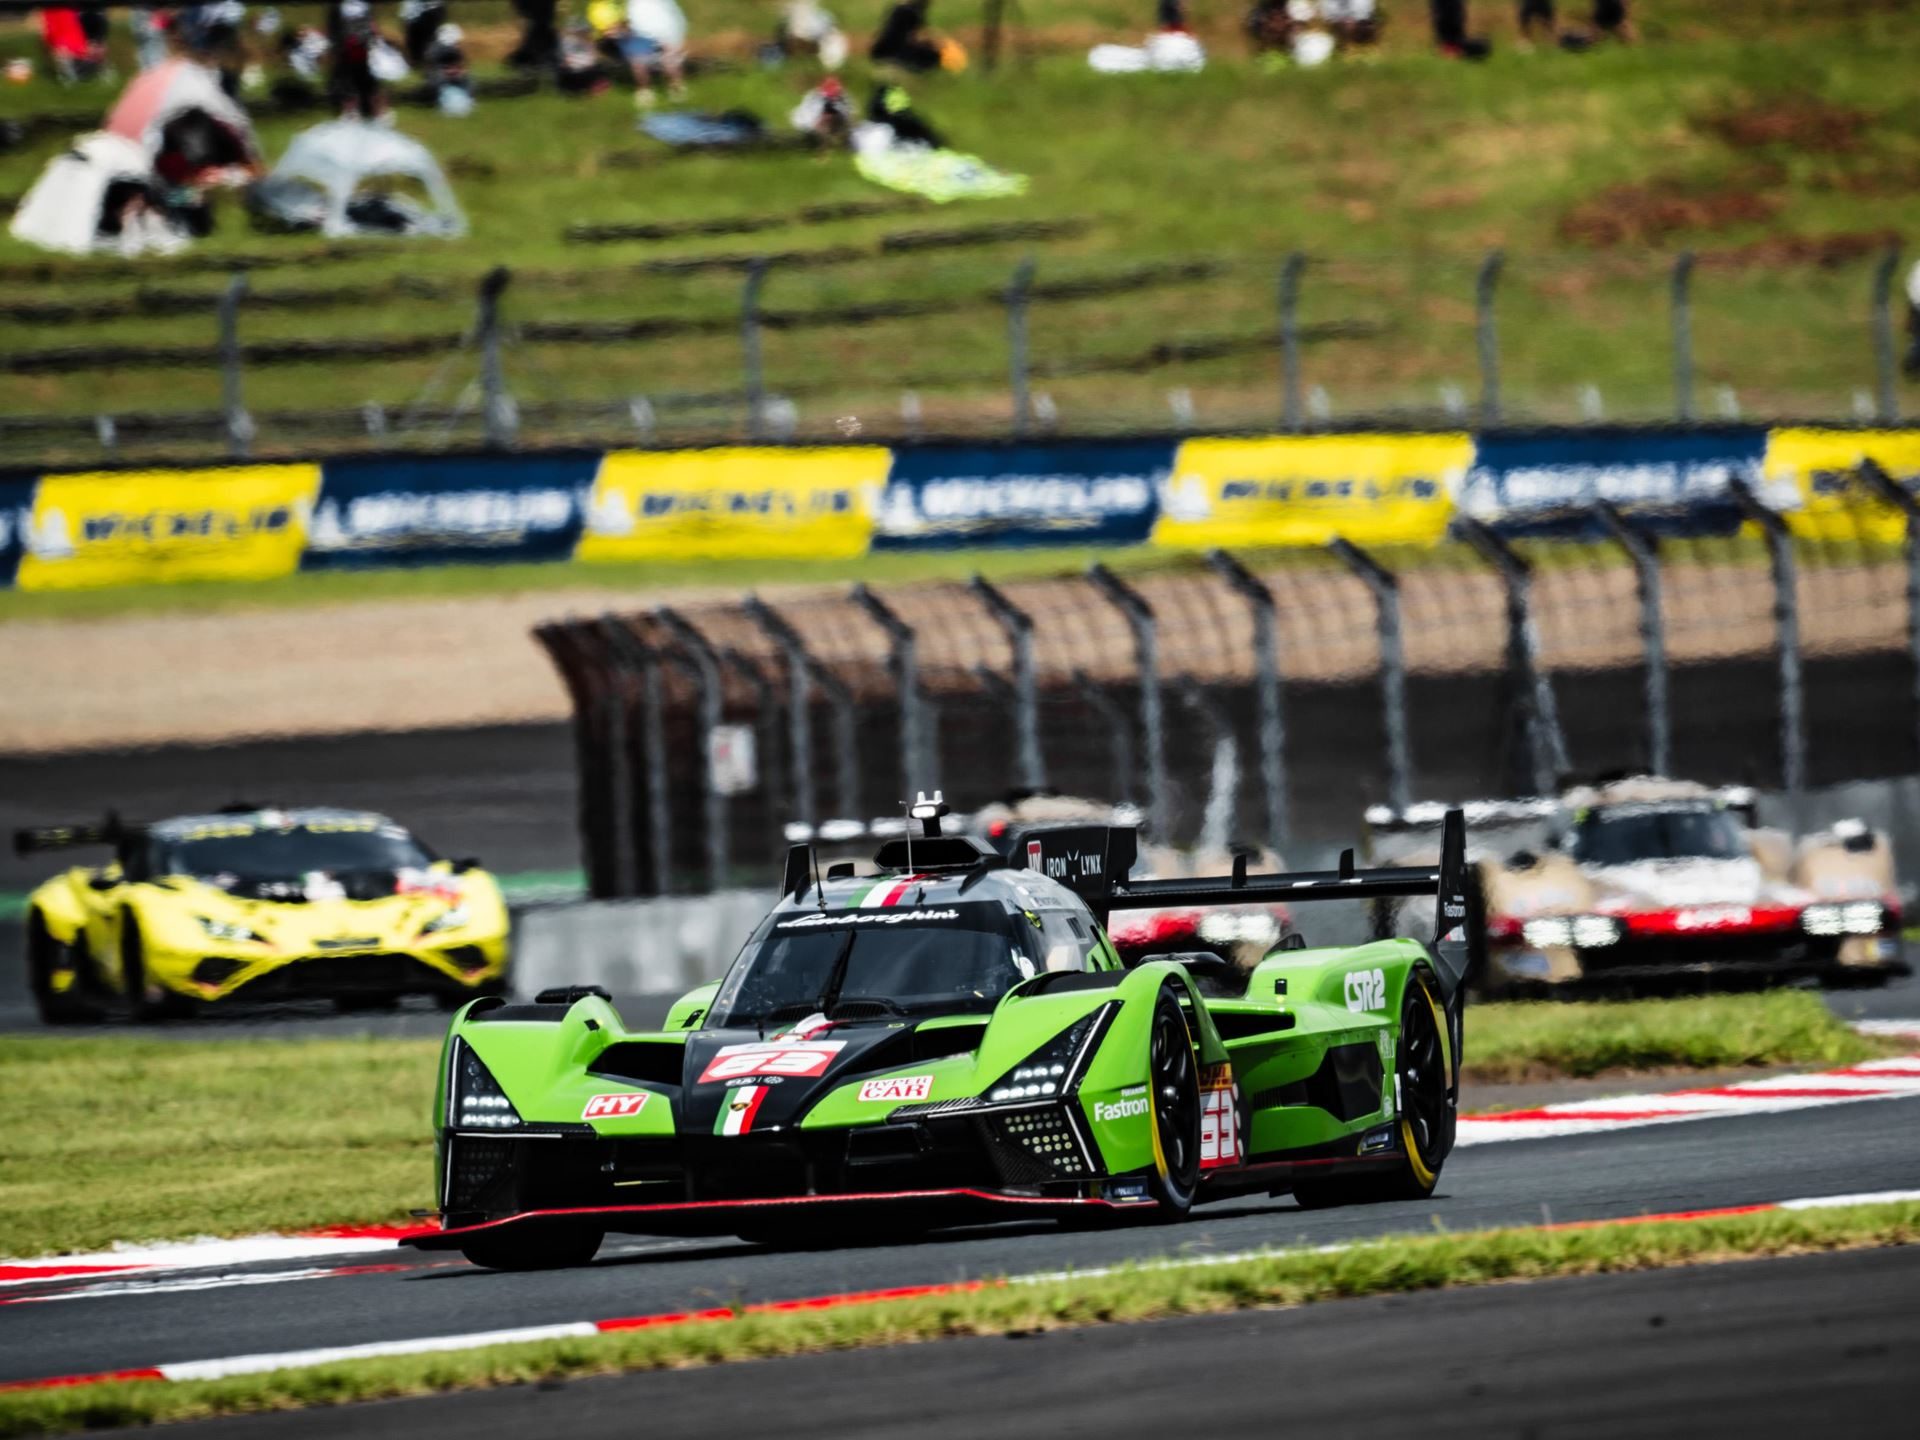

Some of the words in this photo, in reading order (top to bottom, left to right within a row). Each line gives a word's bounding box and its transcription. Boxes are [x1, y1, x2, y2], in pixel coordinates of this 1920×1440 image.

[1046, 857, 1067, 877] IRON
[1080, 854, 1101, 875] LYNX
[776, 909, 960, 929] Lamborghini
[1344, 967, 1386, 1013] CSR2
[707, 1051, 829, 1078] 63
[864, 1084, 924, 1099] CAR
[588, 1095, 644, 1115] HY
[1094, 1097, 1149, 1122] Fastron
